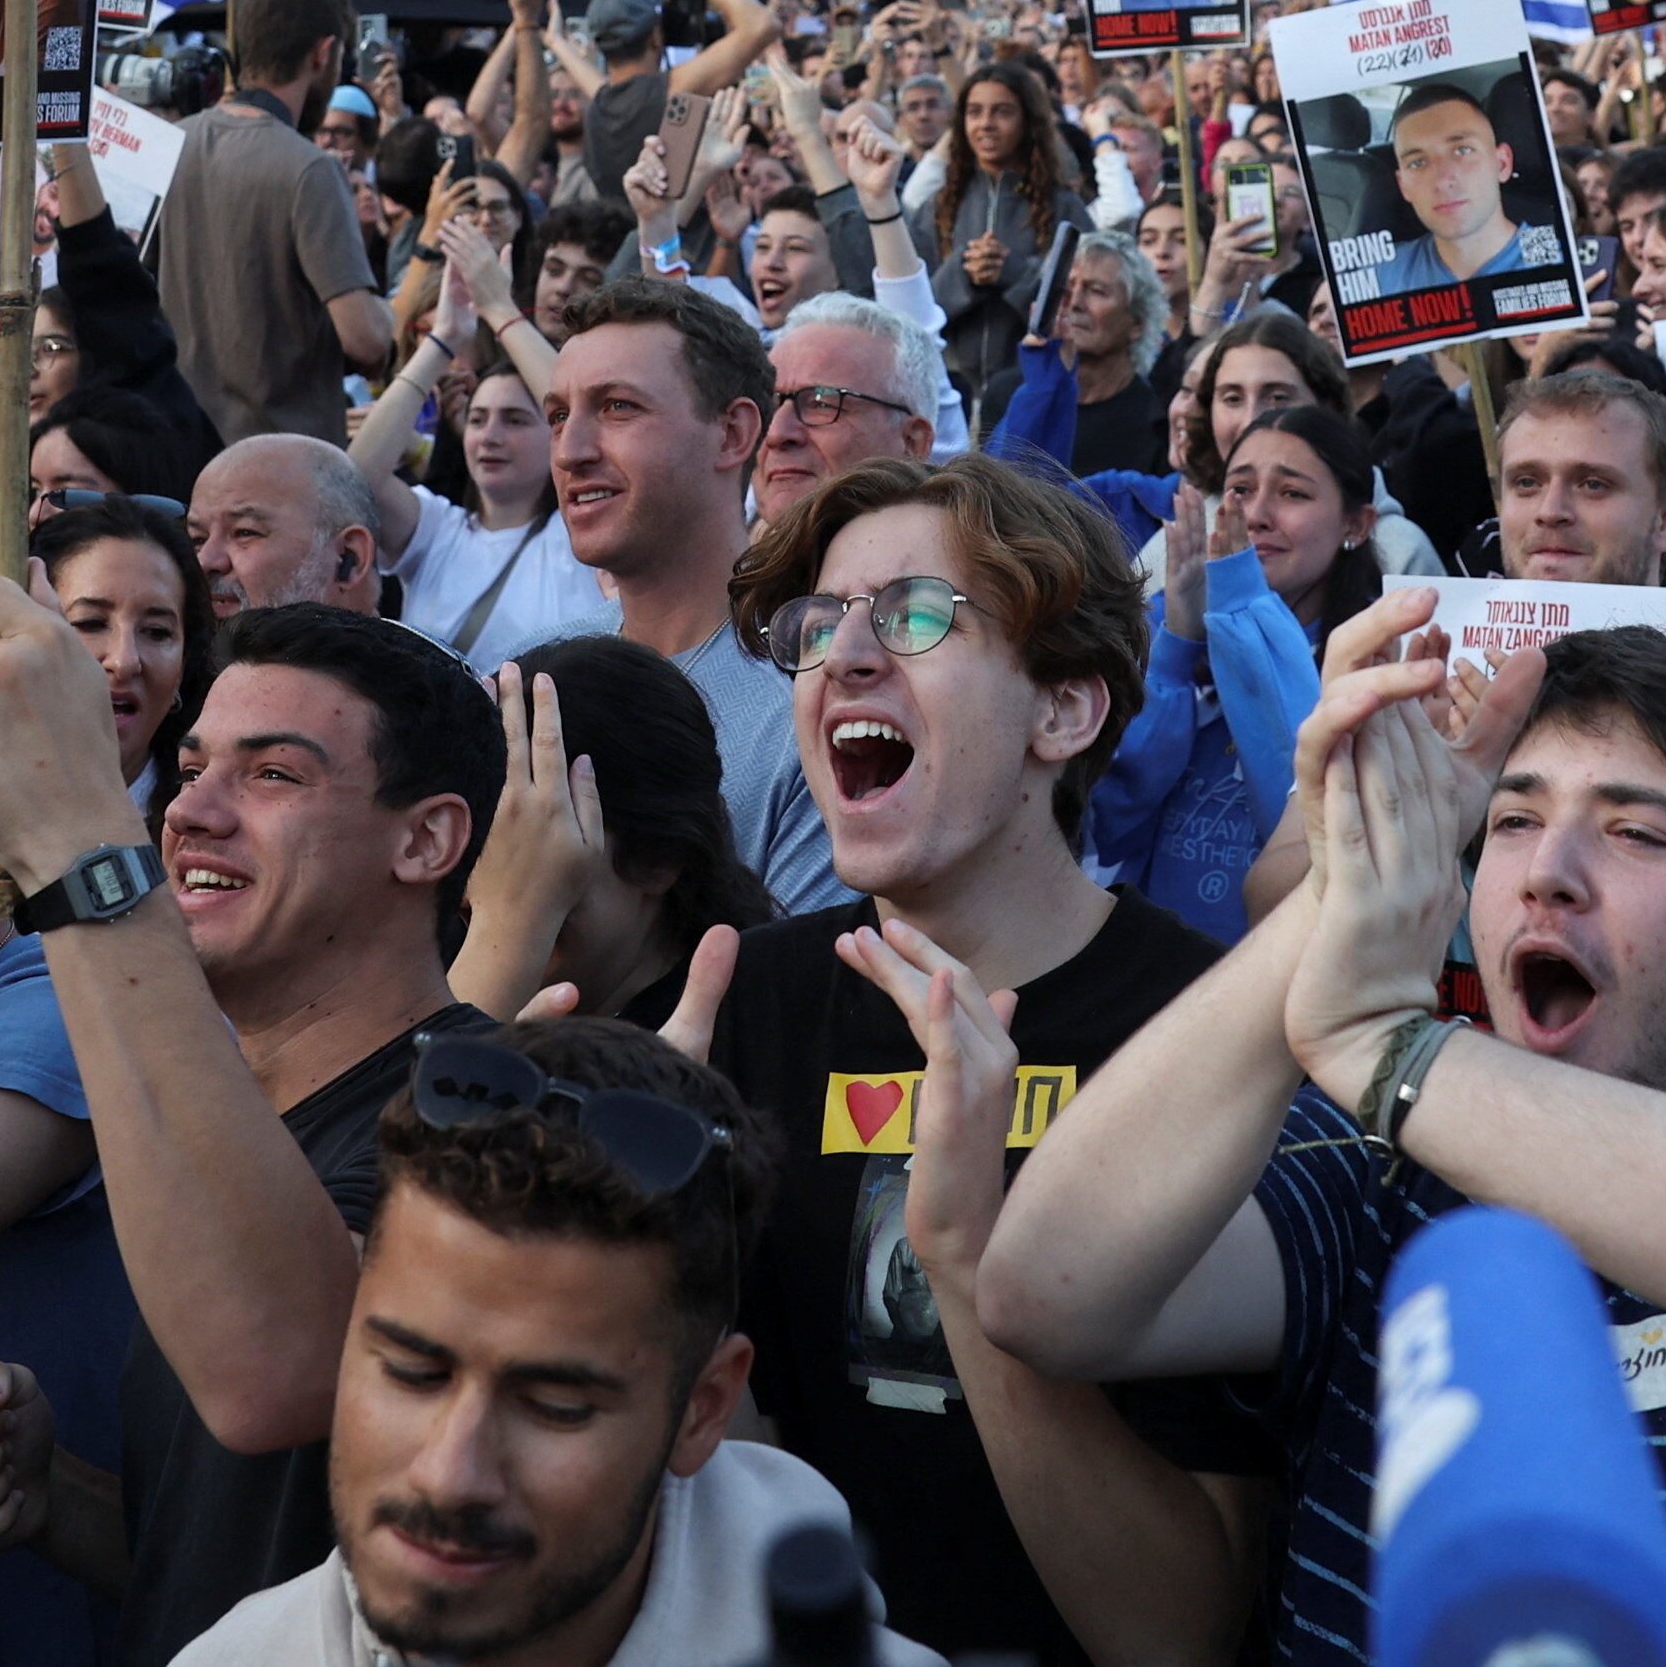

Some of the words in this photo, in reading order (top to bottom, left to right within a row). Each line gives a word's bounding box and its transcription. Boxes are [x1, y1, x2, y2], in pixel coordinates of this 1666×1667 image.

[1096, 14, 1136, 38] HOME
[1137, 10, 1178, 34] NOW!
[1348, 29, 1392, 54] MATAN
[1394, 15, 1451, 44] ANGREST
[45, 104, 80, 124] FORUM
[1328, 229, 1397, 274] BRING
[1336, 266, 1382, 306] HIM
[1344, 299, 1409, 340] HOME
[1409, 283, 1474, 327] NOW!
[1486, 600, 1536, 625] צנגאוקר
[1541, 602, 1570, 628] מתן
[1462, 625, 1503, 650] MATAN
